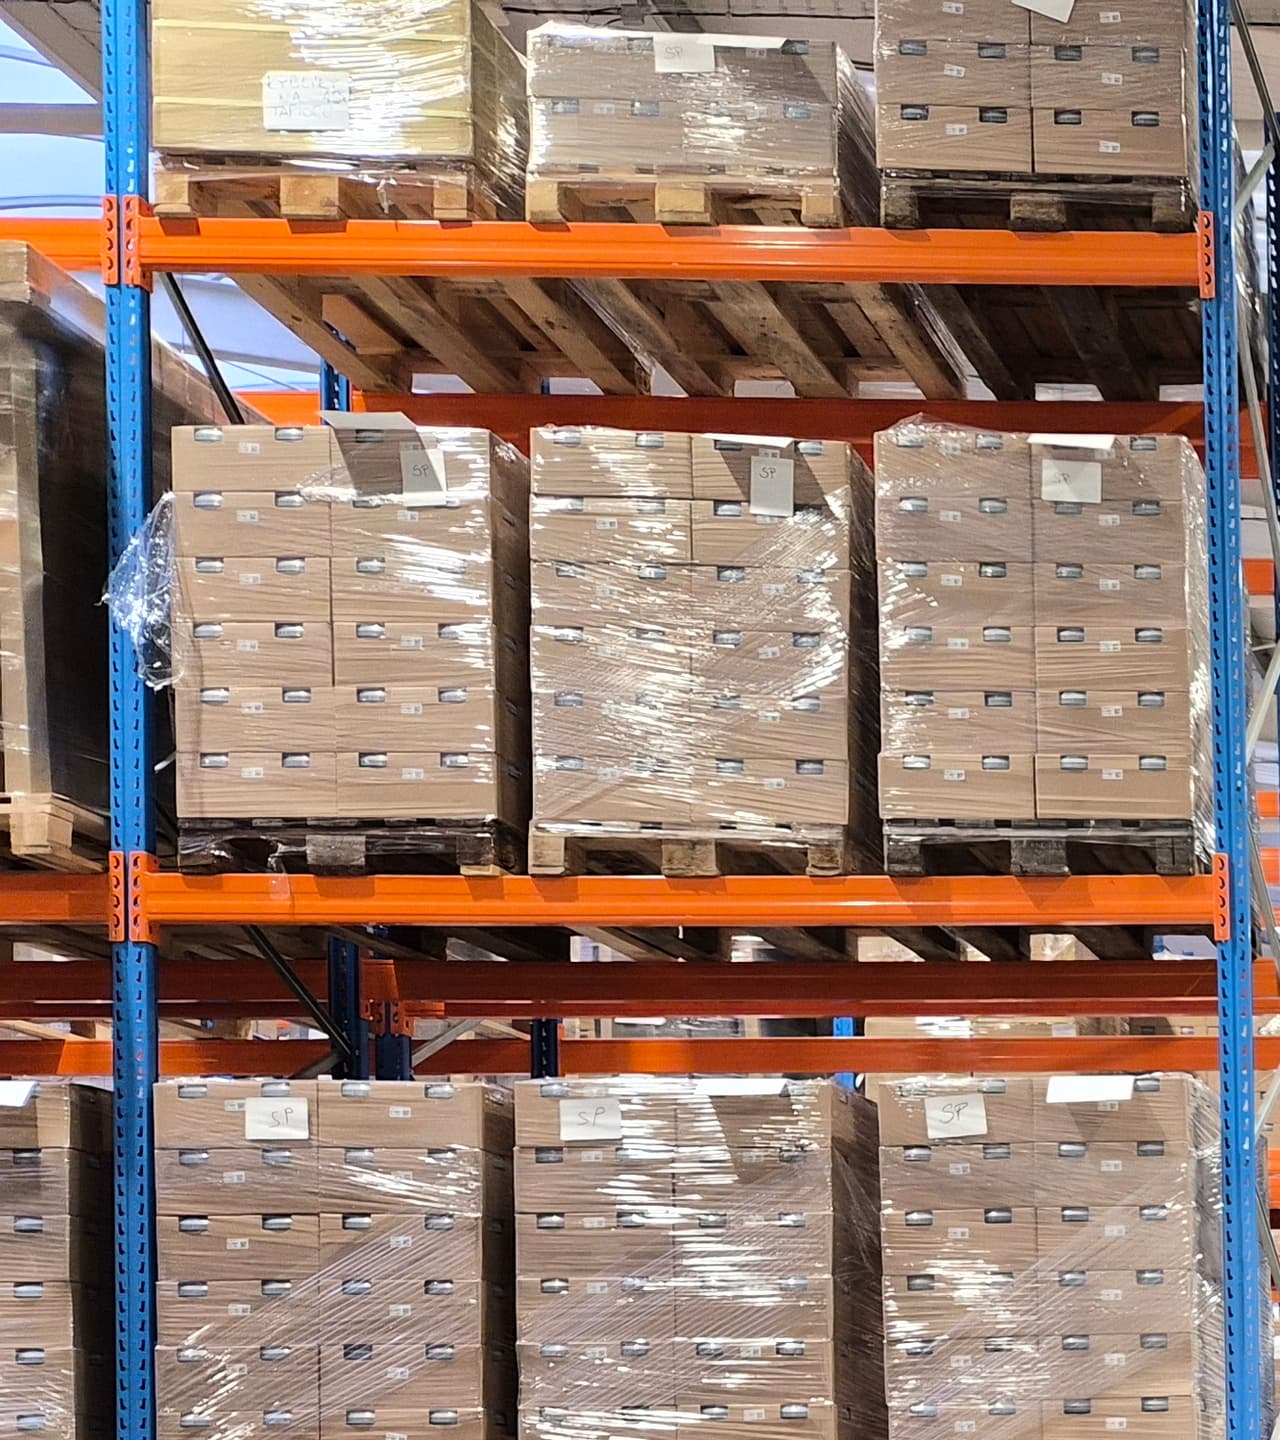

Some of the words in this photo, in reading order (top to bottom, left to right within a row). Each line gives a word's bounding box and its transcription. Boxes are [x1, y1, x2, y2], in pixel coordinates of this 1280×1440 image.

[759, 466, 777, 479] SP
[268, 1107, 294, 1128] SP
[577, 1106, 606, 1128] SP
[939, 1102, 969, 1124] SP
